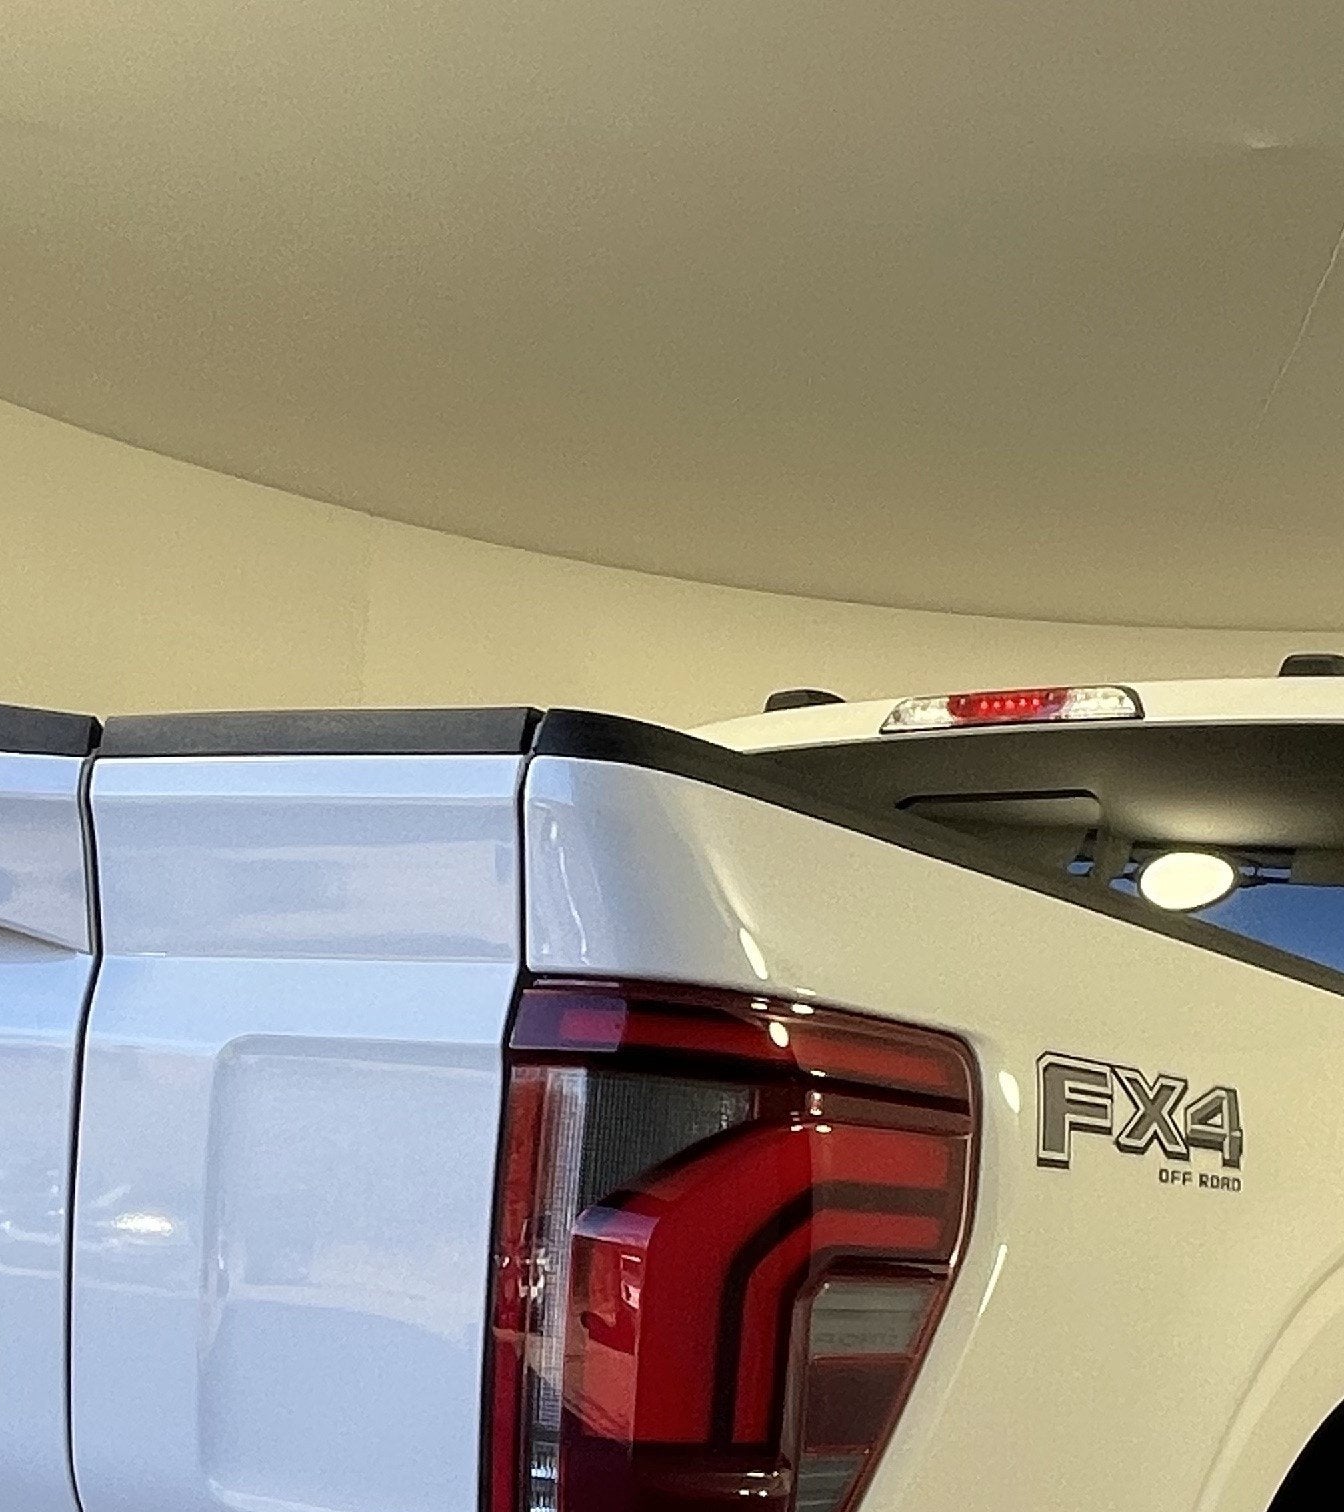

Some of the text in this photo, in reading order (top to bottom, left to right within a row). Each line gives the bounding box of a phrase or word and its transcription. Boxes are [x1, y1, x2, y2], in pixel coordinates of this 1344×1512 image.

[1036, 1050, 1244, 1169] FX4
[1158, 1167, 1242, 1192] OFF ROAD
